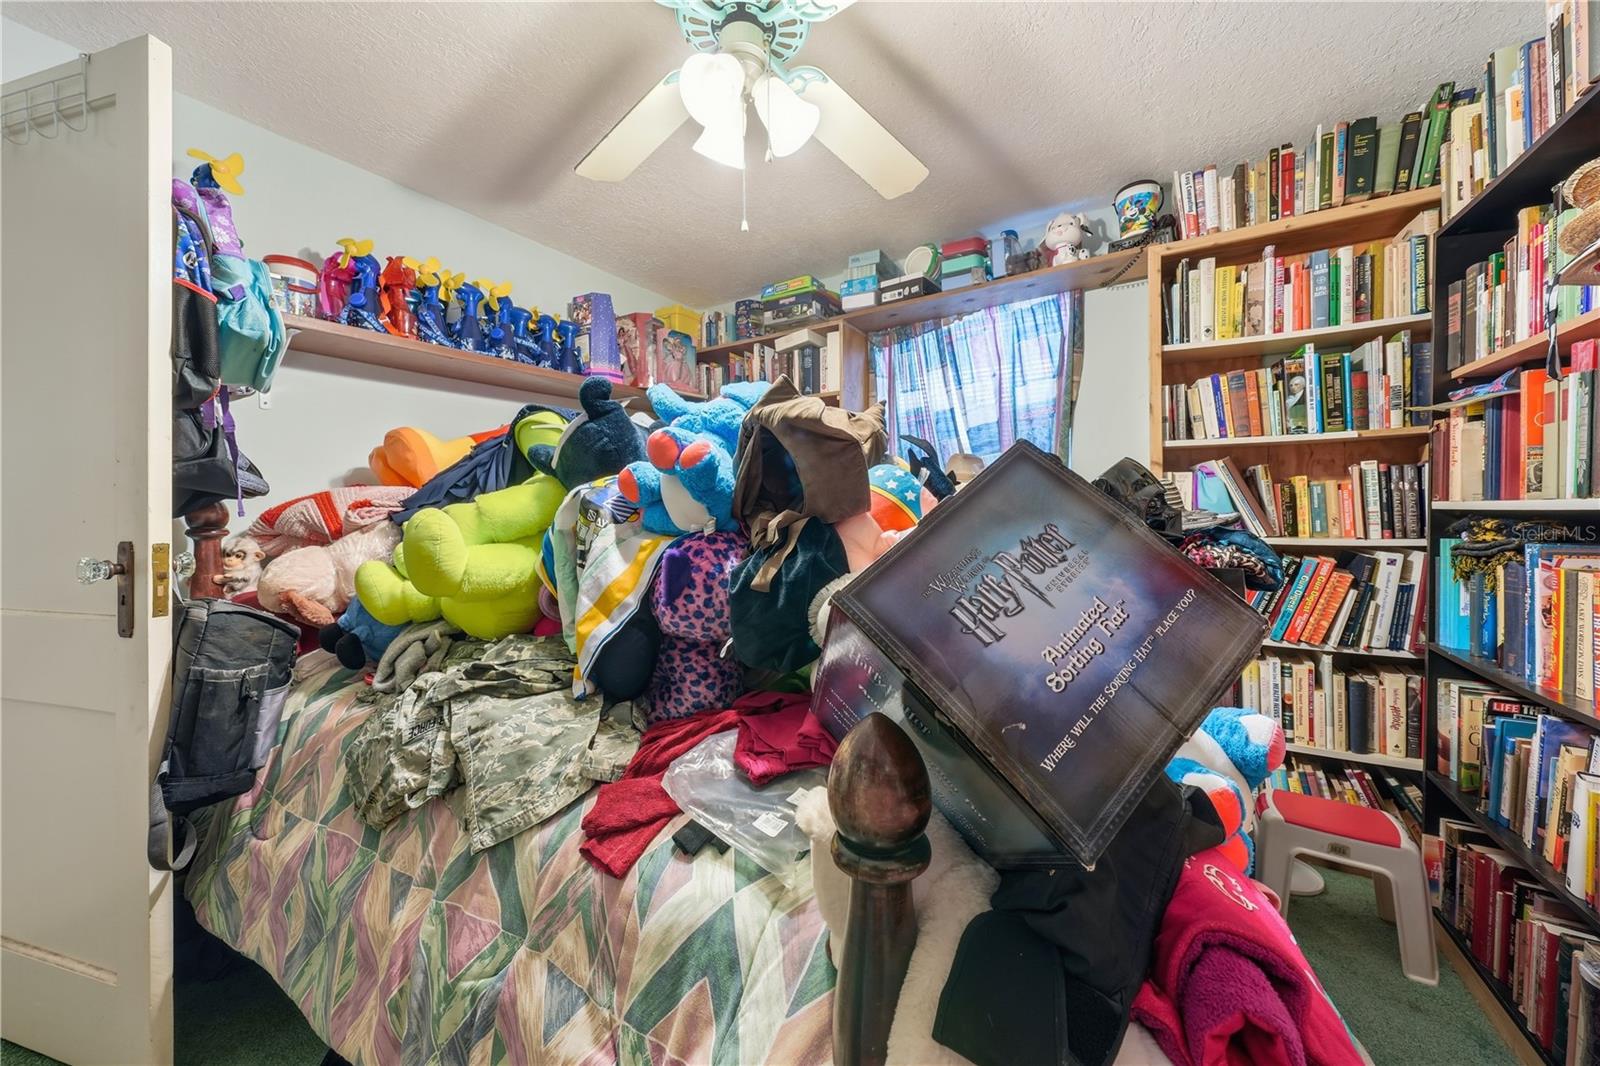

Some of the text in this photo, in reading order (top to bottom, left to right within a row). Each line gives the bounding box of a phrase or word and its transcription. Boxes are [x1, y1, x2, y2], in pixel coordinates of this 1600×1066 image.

[1391, 384, 1402, 411] GAMBLING
[949, 522, 1076, 648] Harry Potter
[1287, 589, 1303, 612] Digest
[1302, 590, 1318, 612] Digest
[1041, 595, 1109, 666] Animated
[1045, 636, 1105, 693] Sorting
[1040, 734, 1077, 773] WHERE
[1070, 713, 1093, 738] WILL
[1088, 694, 1108, 714] THE
[1104, 659, 1137, 699] SORTING
[1155, 609, 1179, 637] PLACE
[1175, 588, 1197, 612] YOU?
[1272, 683, 1280, 703] HEALTH
[1389, 705, 1404, 731] Heloise
[1492, 702, 1520, 713] LIFE
